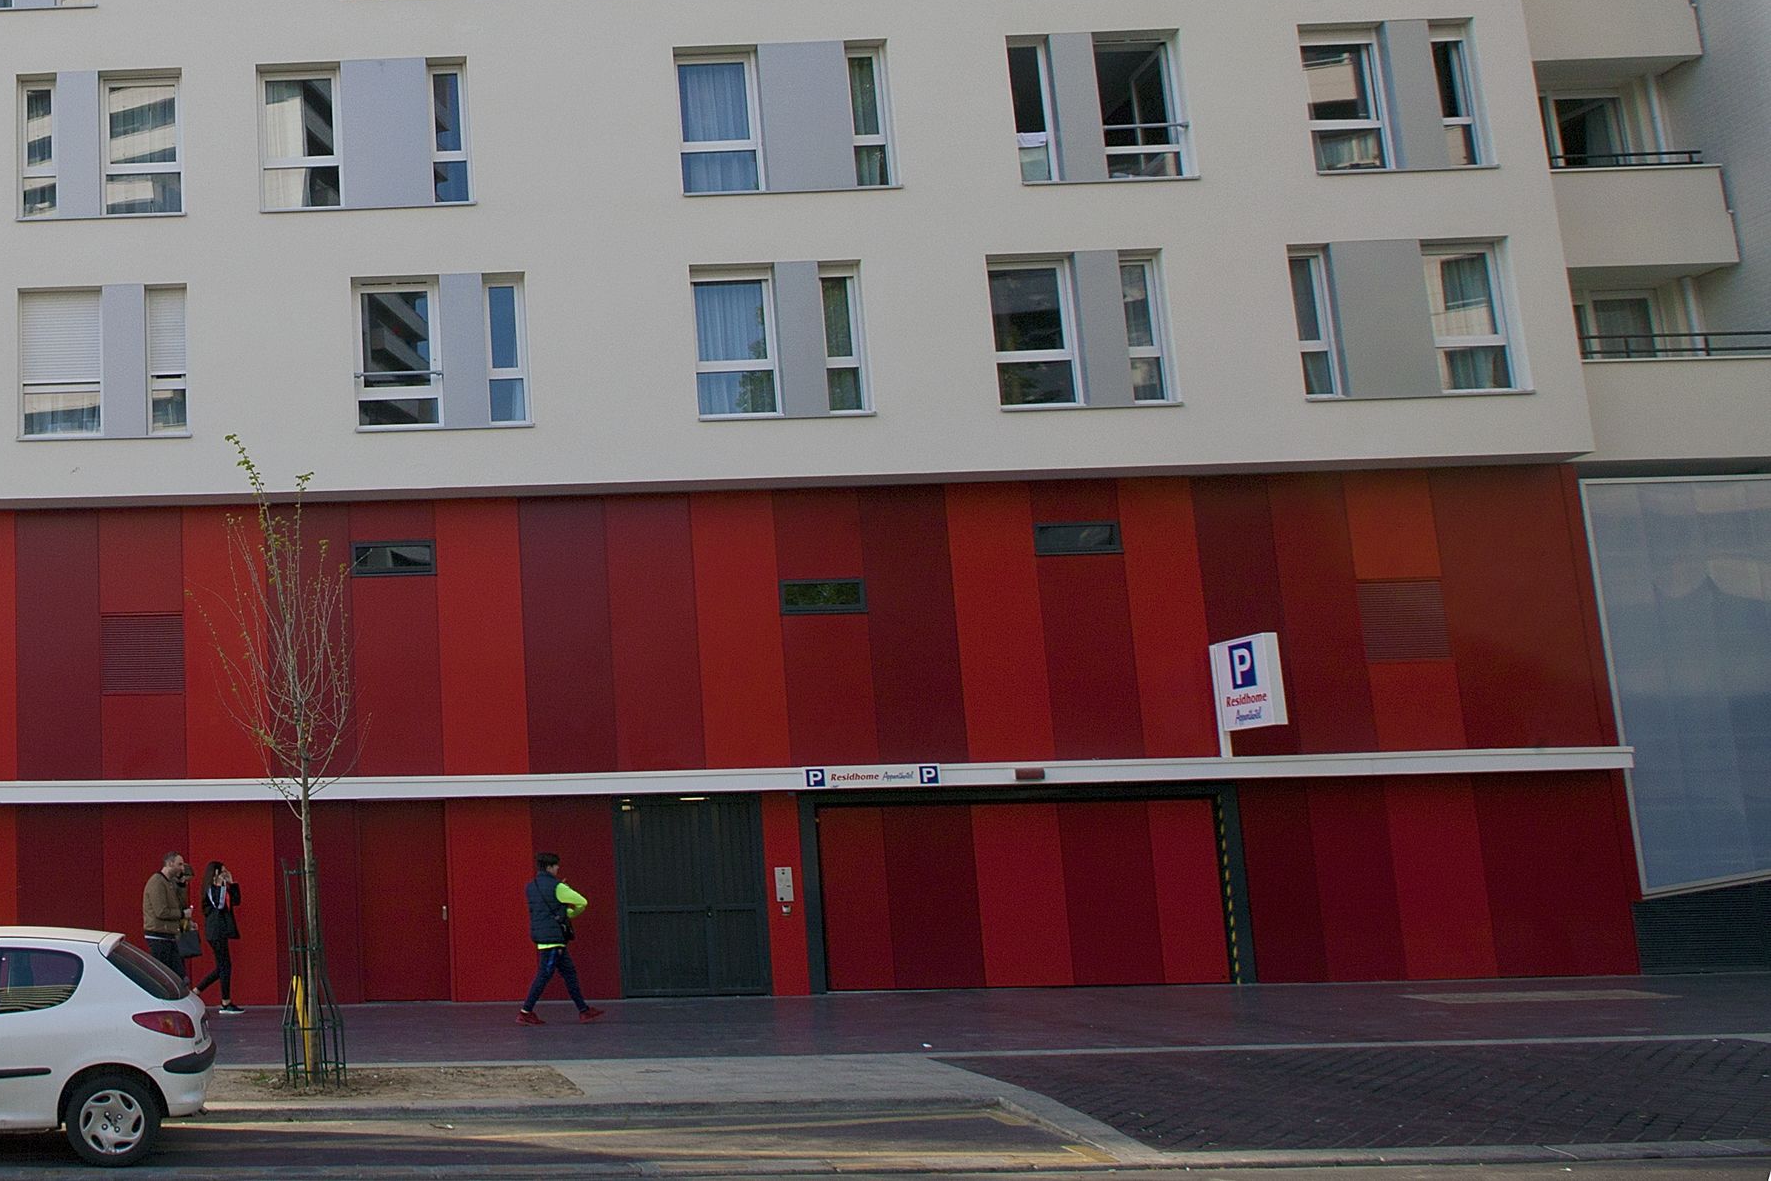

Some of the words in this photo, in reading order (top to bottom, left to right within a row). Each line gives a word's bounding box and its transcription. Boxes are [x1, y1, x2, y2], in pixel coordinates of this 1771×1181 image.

[1232, 648, 1252, 685] P
[1226, 693, 1267, 708] Residhome
[808, 770, 823, 786] P
[830, 772, 880, 782] Residhome
[921, 767, 936, 783] P
